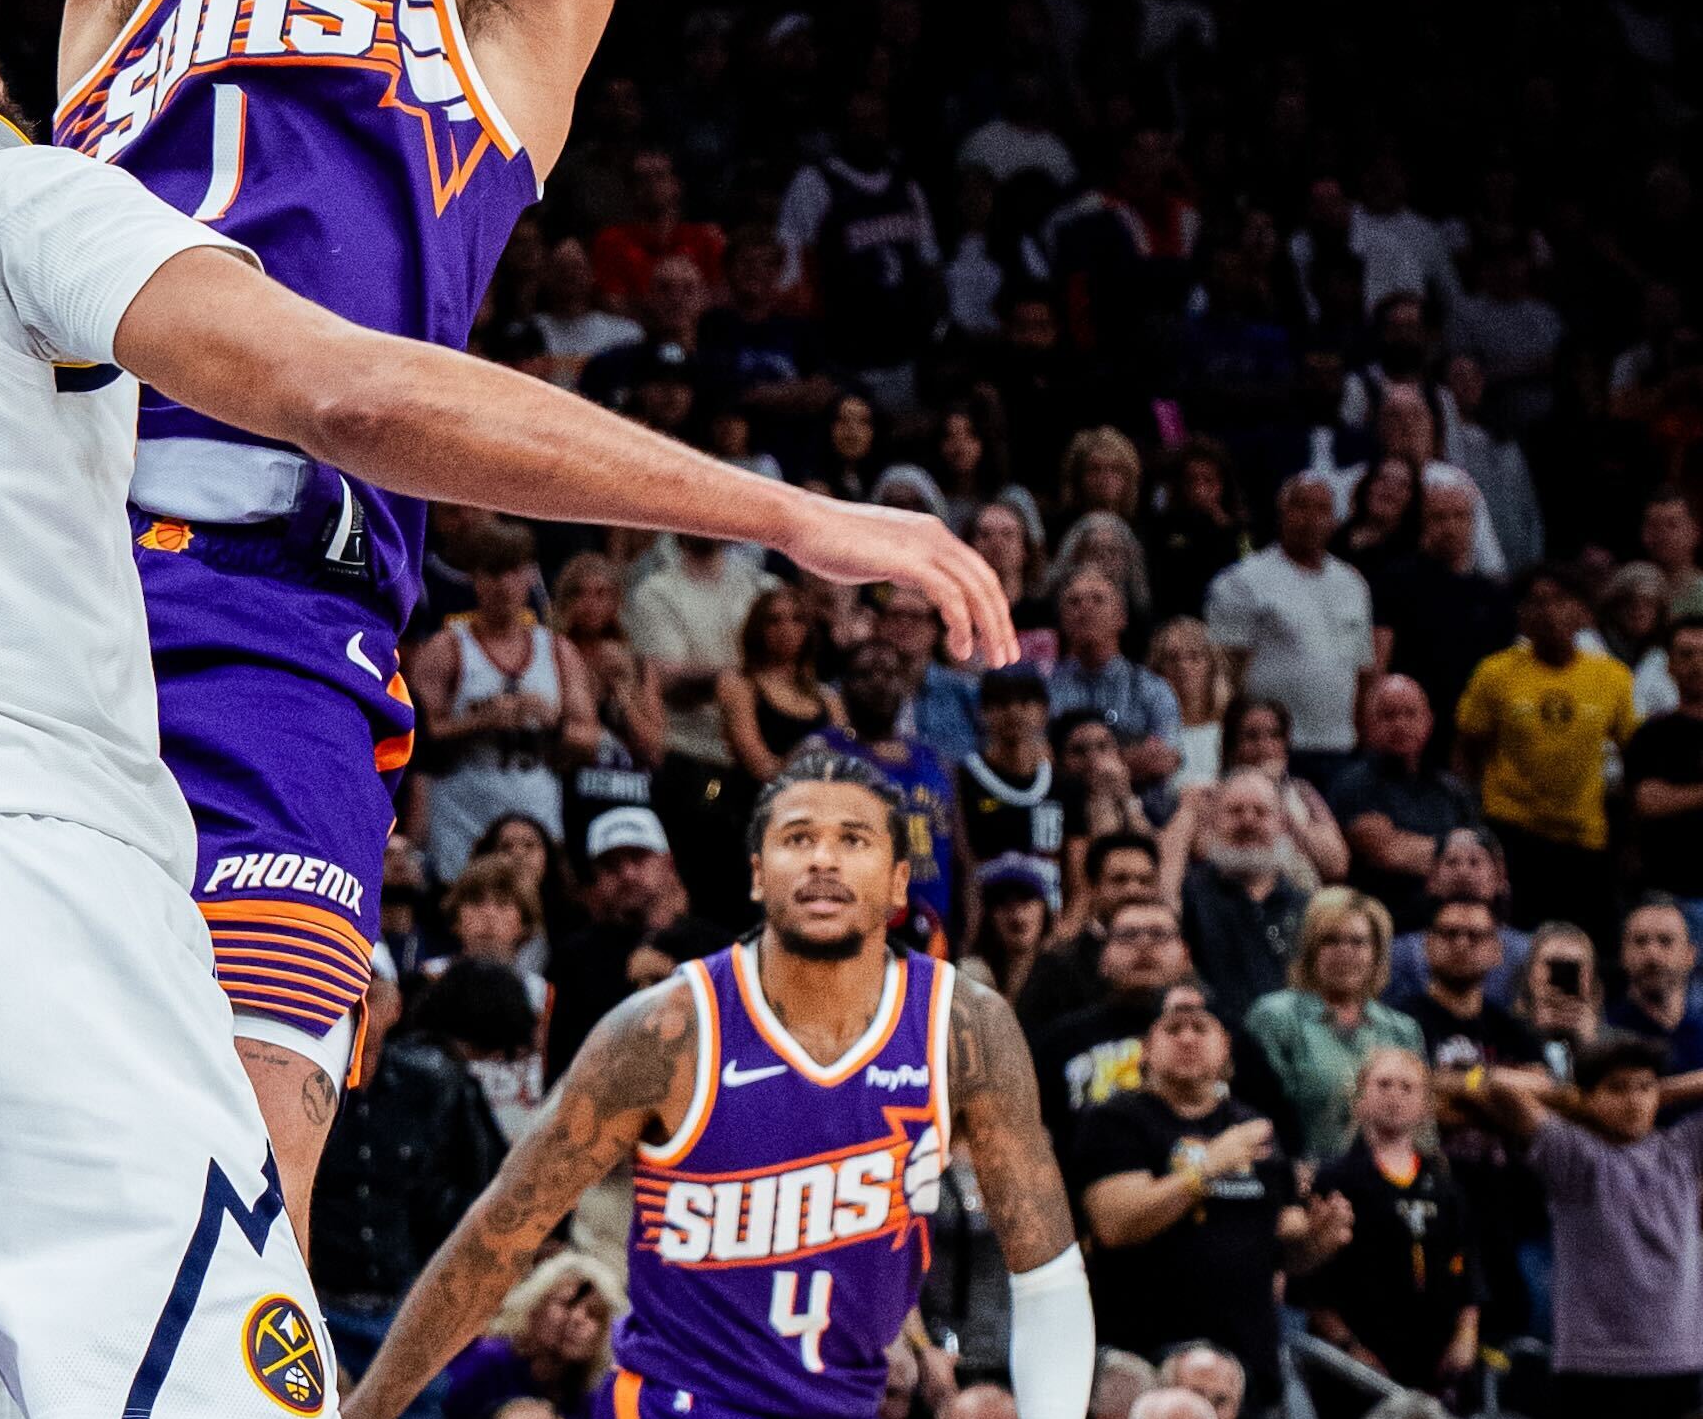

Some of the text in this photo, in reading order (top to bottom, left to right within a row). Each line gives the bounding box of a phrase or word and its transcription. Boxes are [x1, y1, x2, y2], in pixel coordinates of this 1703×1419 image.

[203, 852, 364, 917] PHOENIX
[865, 1063, 930, 1093] PayPal
[658, 1149, 896, 1263] SUNS
[769, 1270, 833, 1374] 4
